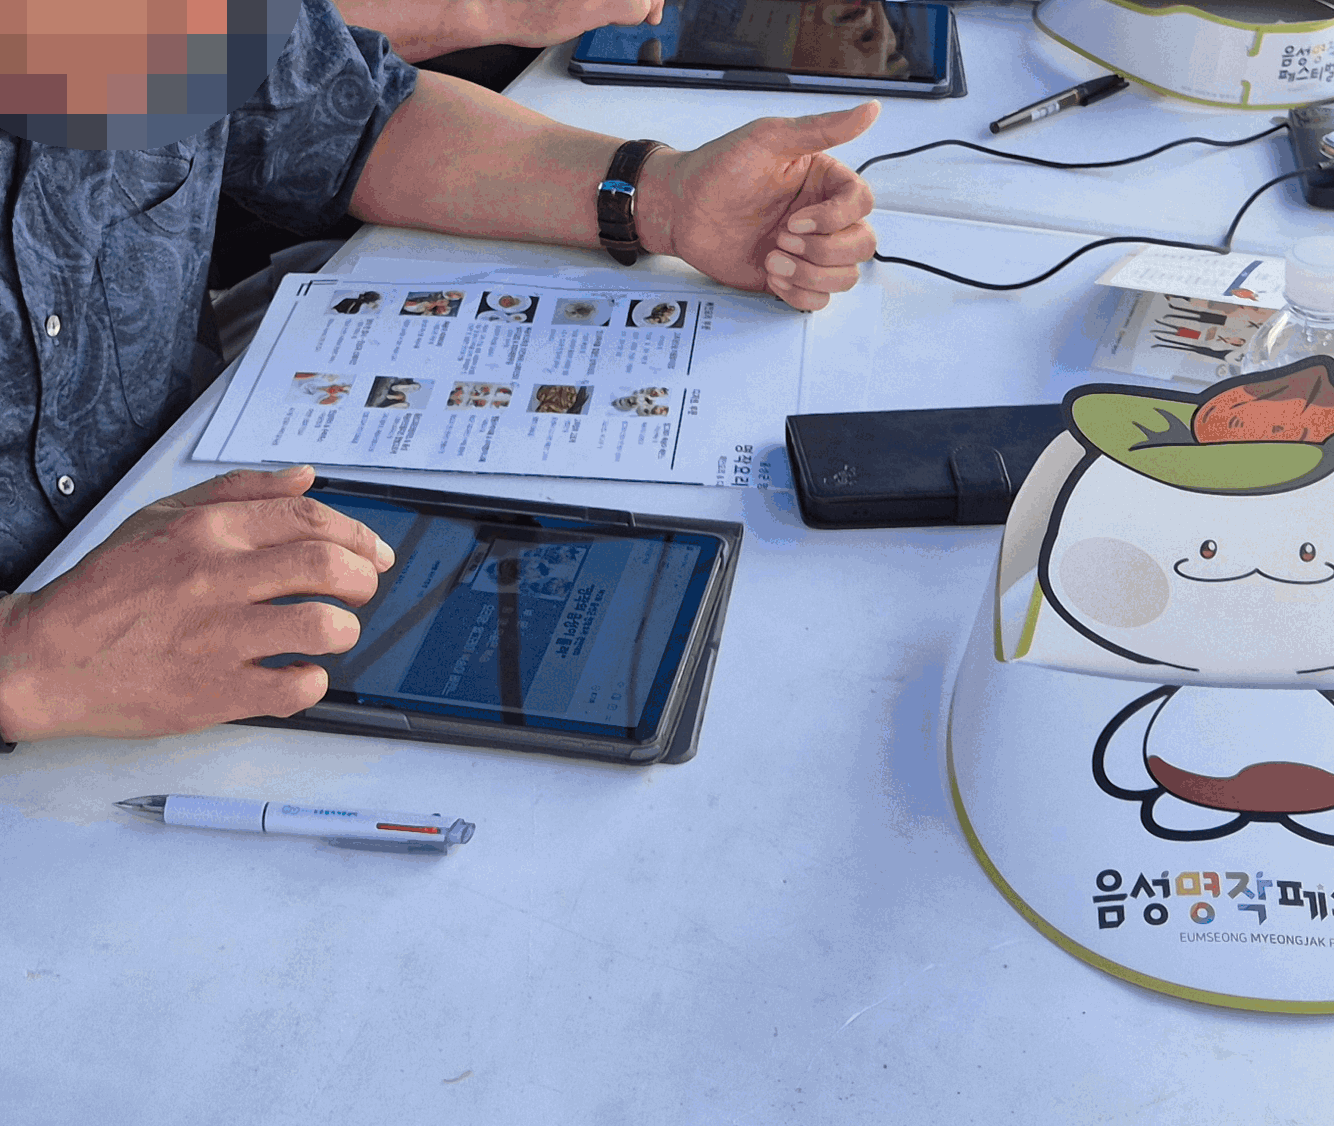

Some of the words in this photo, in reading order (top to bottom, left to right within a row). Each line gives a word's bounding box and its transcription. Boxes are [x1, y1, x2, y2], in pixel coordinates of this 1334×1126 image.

[732, 445, 753, 487] 명작요리
[1179, 931, 1248, 944] EUMSEONG
[1250, 933, 1327, 948] MYEONGJAK
